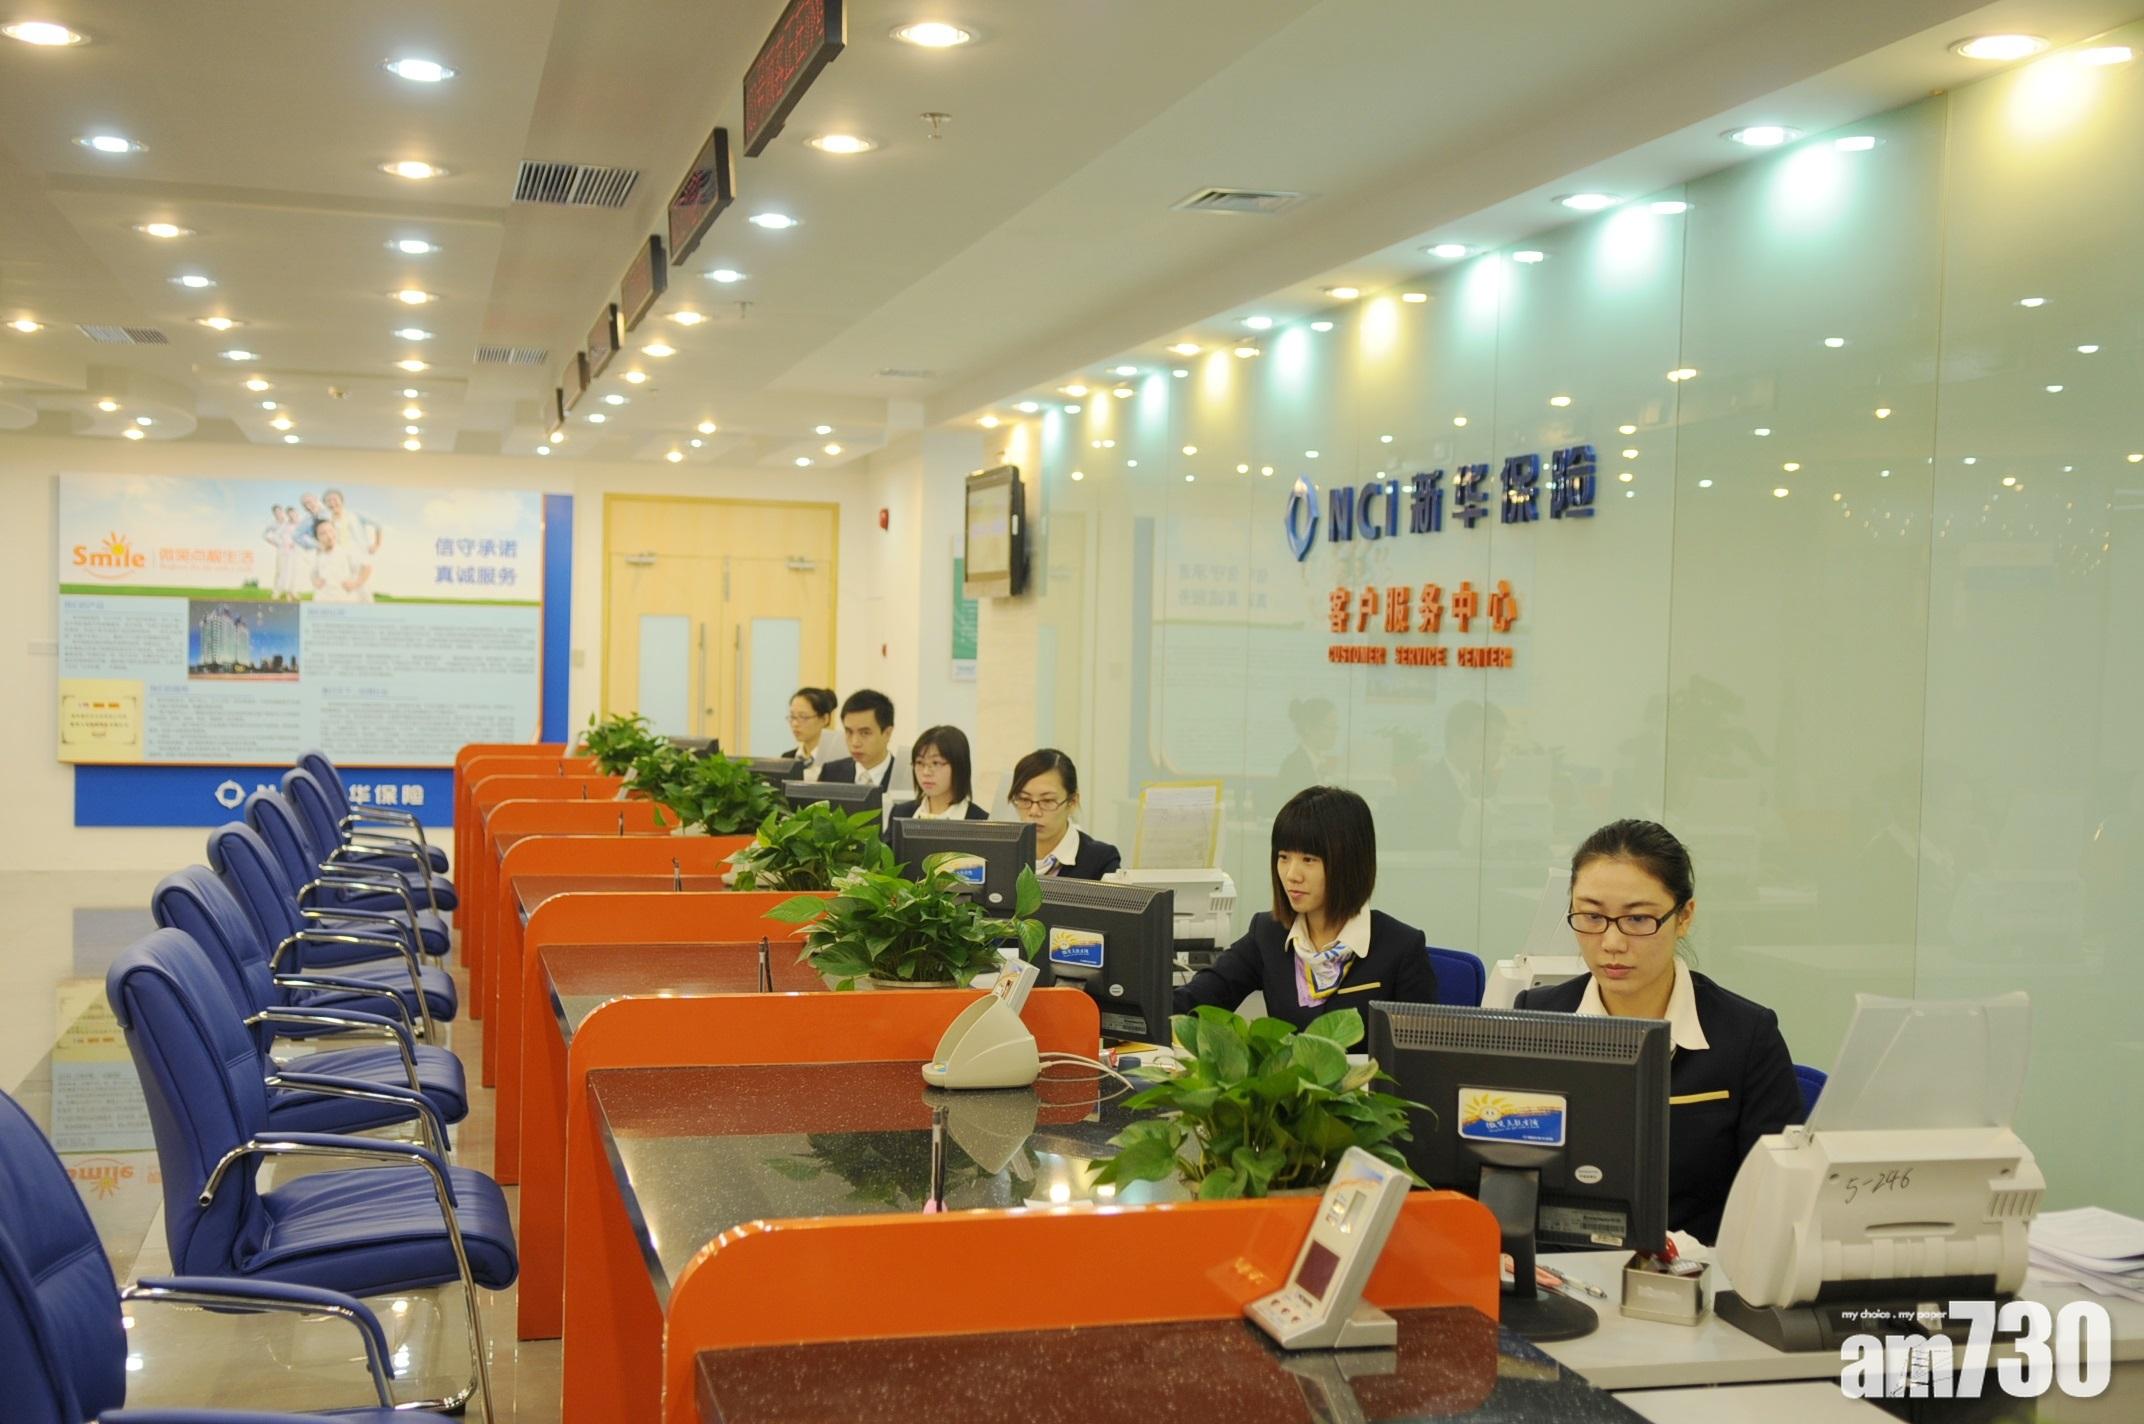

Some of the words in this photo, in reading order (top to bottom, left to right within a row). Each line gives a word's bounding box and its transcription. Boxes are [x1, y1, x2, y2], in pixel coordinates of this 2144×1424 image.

[1328, 479, 1400, 542] NCI
[1410, 444, 1597, 534] 新华保险
[73, 544, 145, 567] Smile
[435, 537, 517, 558] 信守承诺
[435, 565, 516, 585] 真诚服务
[1328, 579, 1518, 634] 客户服务中心
[1328, 645, 1387, 665] CUSTOMER
[1395, 646, 1448, 667] SERVICE
[1457, 647, 1514, 668] CENTER
[349, 784, 424, 805] 华保险
